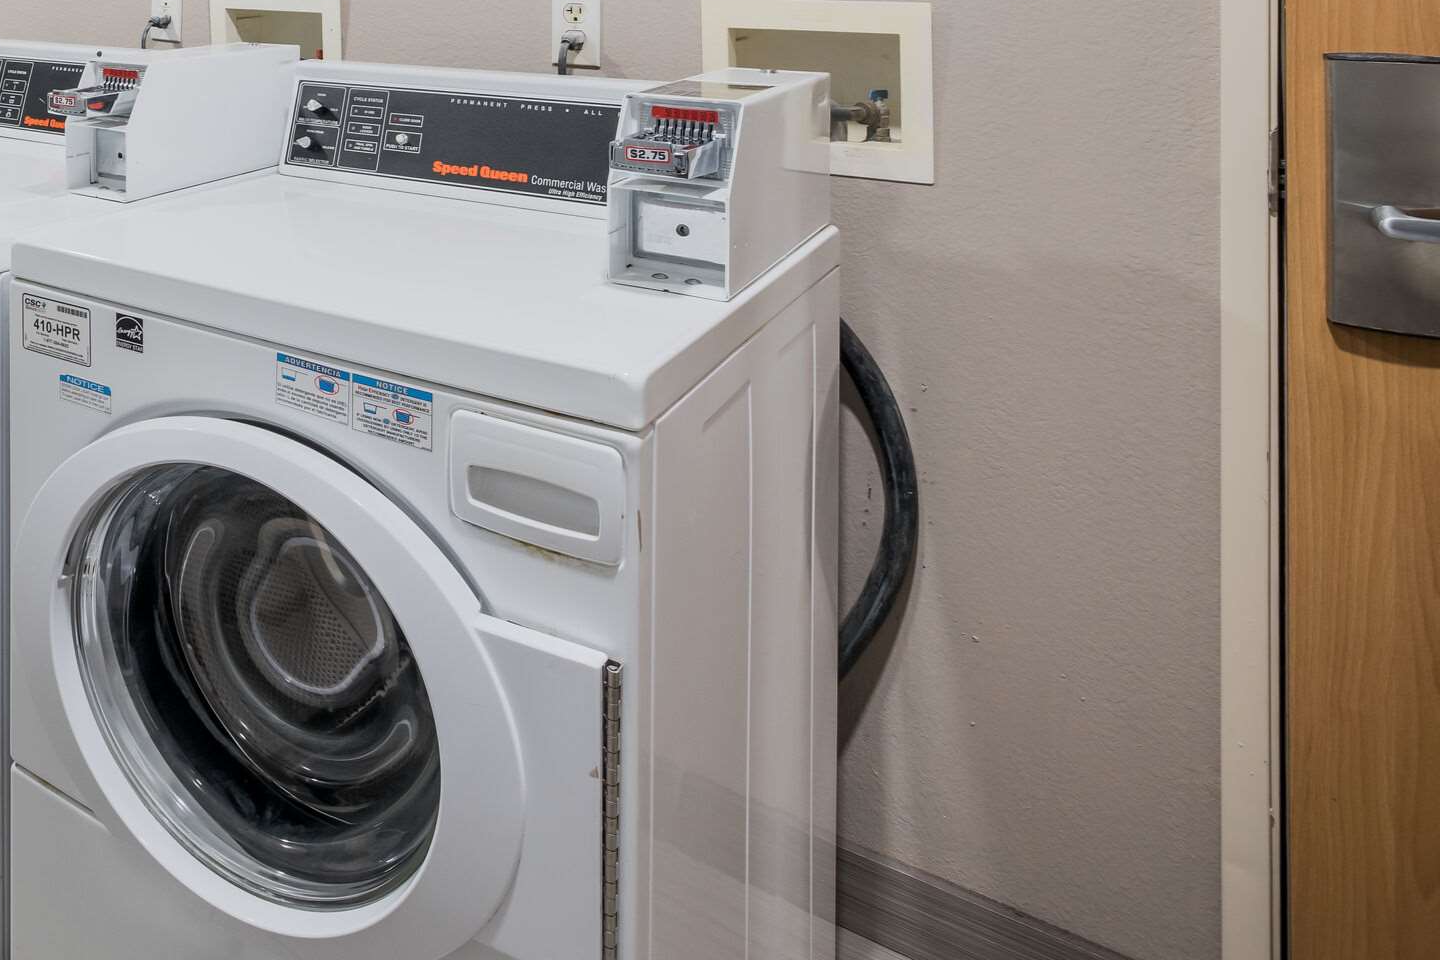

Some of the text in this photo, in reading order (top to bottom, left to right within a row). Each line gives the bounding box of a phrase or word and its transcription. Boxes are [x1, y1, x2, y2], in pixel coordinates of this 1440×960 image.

[450, 98, 509, 109] PERMANENT
[521, 104, 553, 112] PRESS
[24, 116, 50, 127] Speed
[630, 150, 666, 161] $2.75
[432, 160, 607, 194] Speed Queen Commercial Was
[563, 190, 576, 199] High
[576, 192, 603, 202] Efficiency
[25, 298, 41, 307] CSC
[34, 319, 81, 342] 410-HPR
[286, 357, 342, 377] ADVERTENCIA
[67, 376, 106, 394] NOTICE
[376, 381, 409, 395] NOTICE
